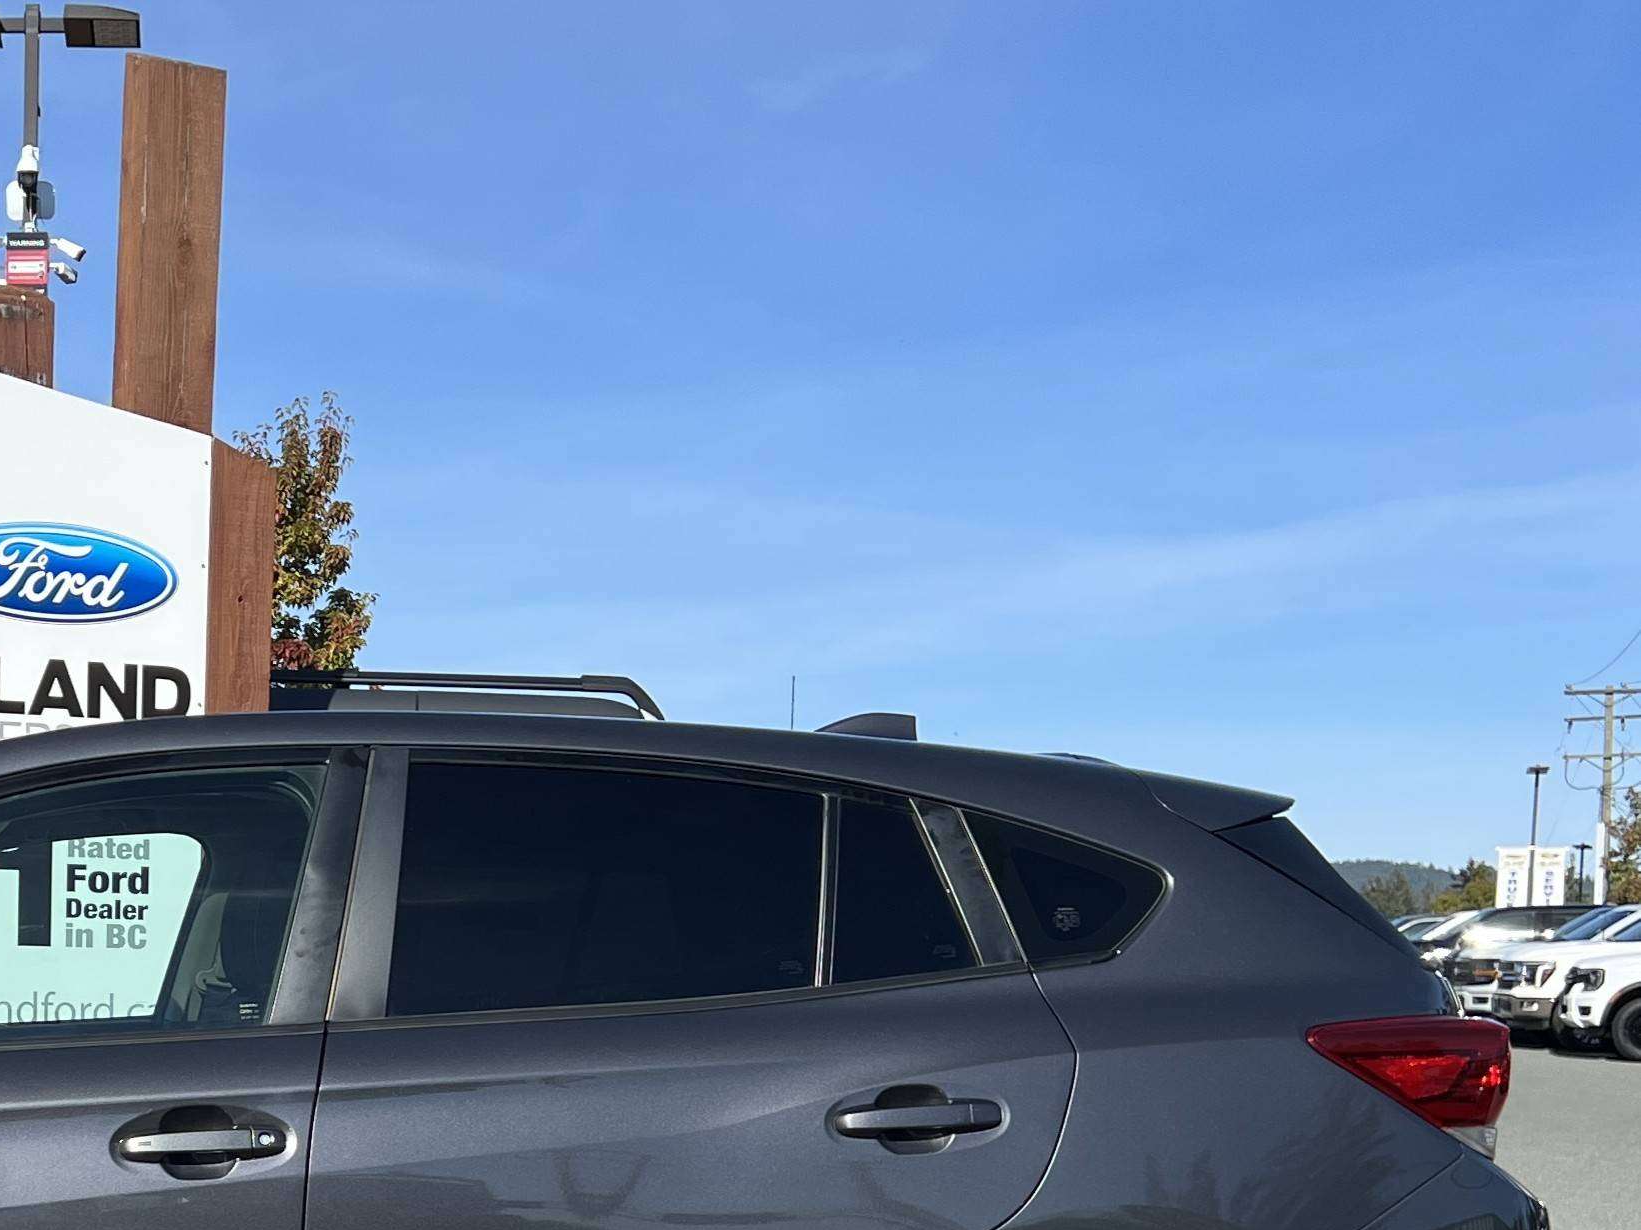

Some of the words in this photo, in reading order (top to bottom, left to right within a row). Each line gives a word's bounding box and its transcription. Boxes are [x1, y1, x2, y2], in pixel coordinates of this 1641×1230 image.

[67, 838, 150, 861] Rated
[66, 863, 150, 895] Ford
[65, 898, 149, 921] Dealer
[65, 923, 94, 948] in
[106, 924, 148, 950] BC
